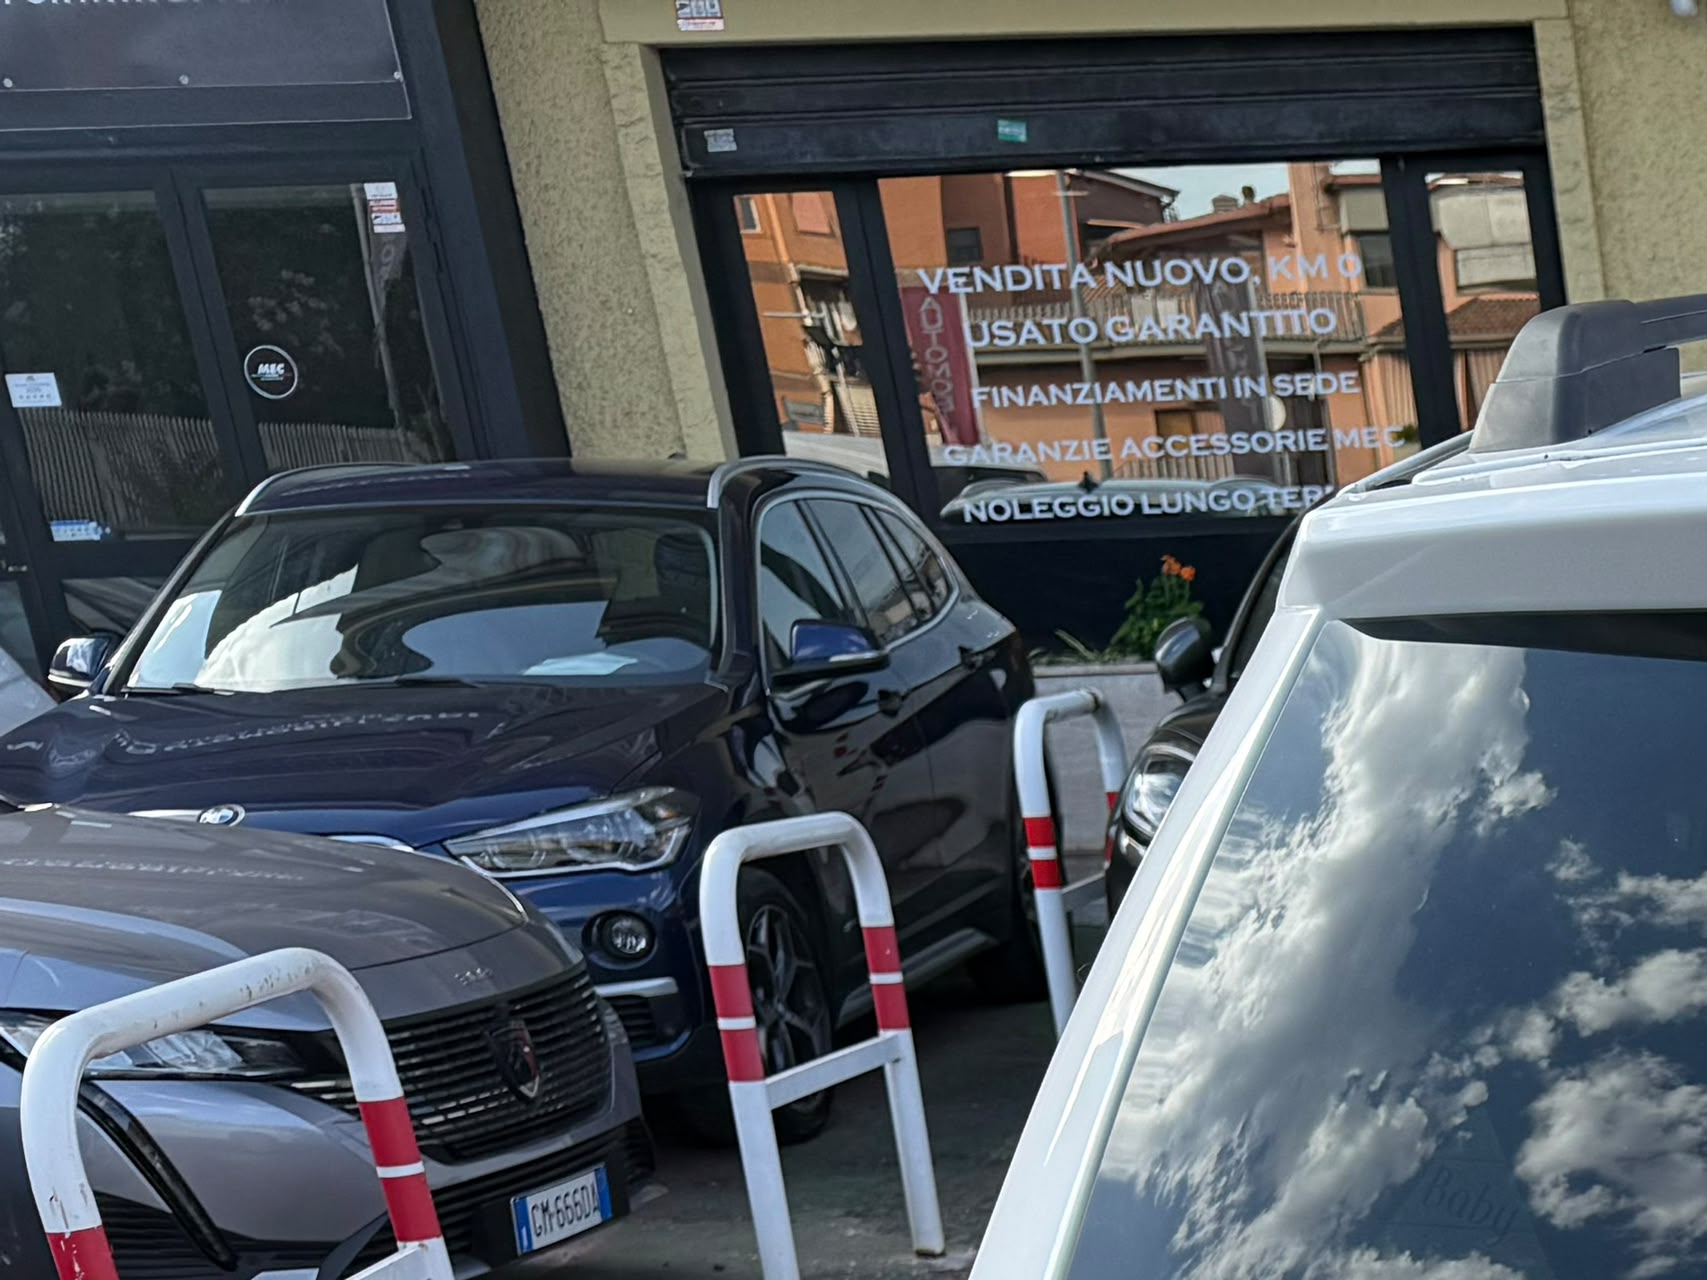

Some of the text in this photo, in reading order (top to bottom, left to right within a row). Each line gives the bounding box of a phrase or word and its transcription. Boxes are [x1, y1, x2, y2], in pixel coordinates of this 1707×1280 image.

[917, 262, 1096, 295] VENDITA
[1104, 256, 1261, 289] NUOVO,
[1268, 254, 1328, 281] KM
[964, 308, 1337, 349] USATO GARANTITO
[970, 370, 1360, 409] FINANZIAMENTI IN SEDE
[943, 425, 1406, 467] GARANZIE ACCESSORIE MEC
[963, 485, 1334, 524] NOLEGGIO LUNGO TER
